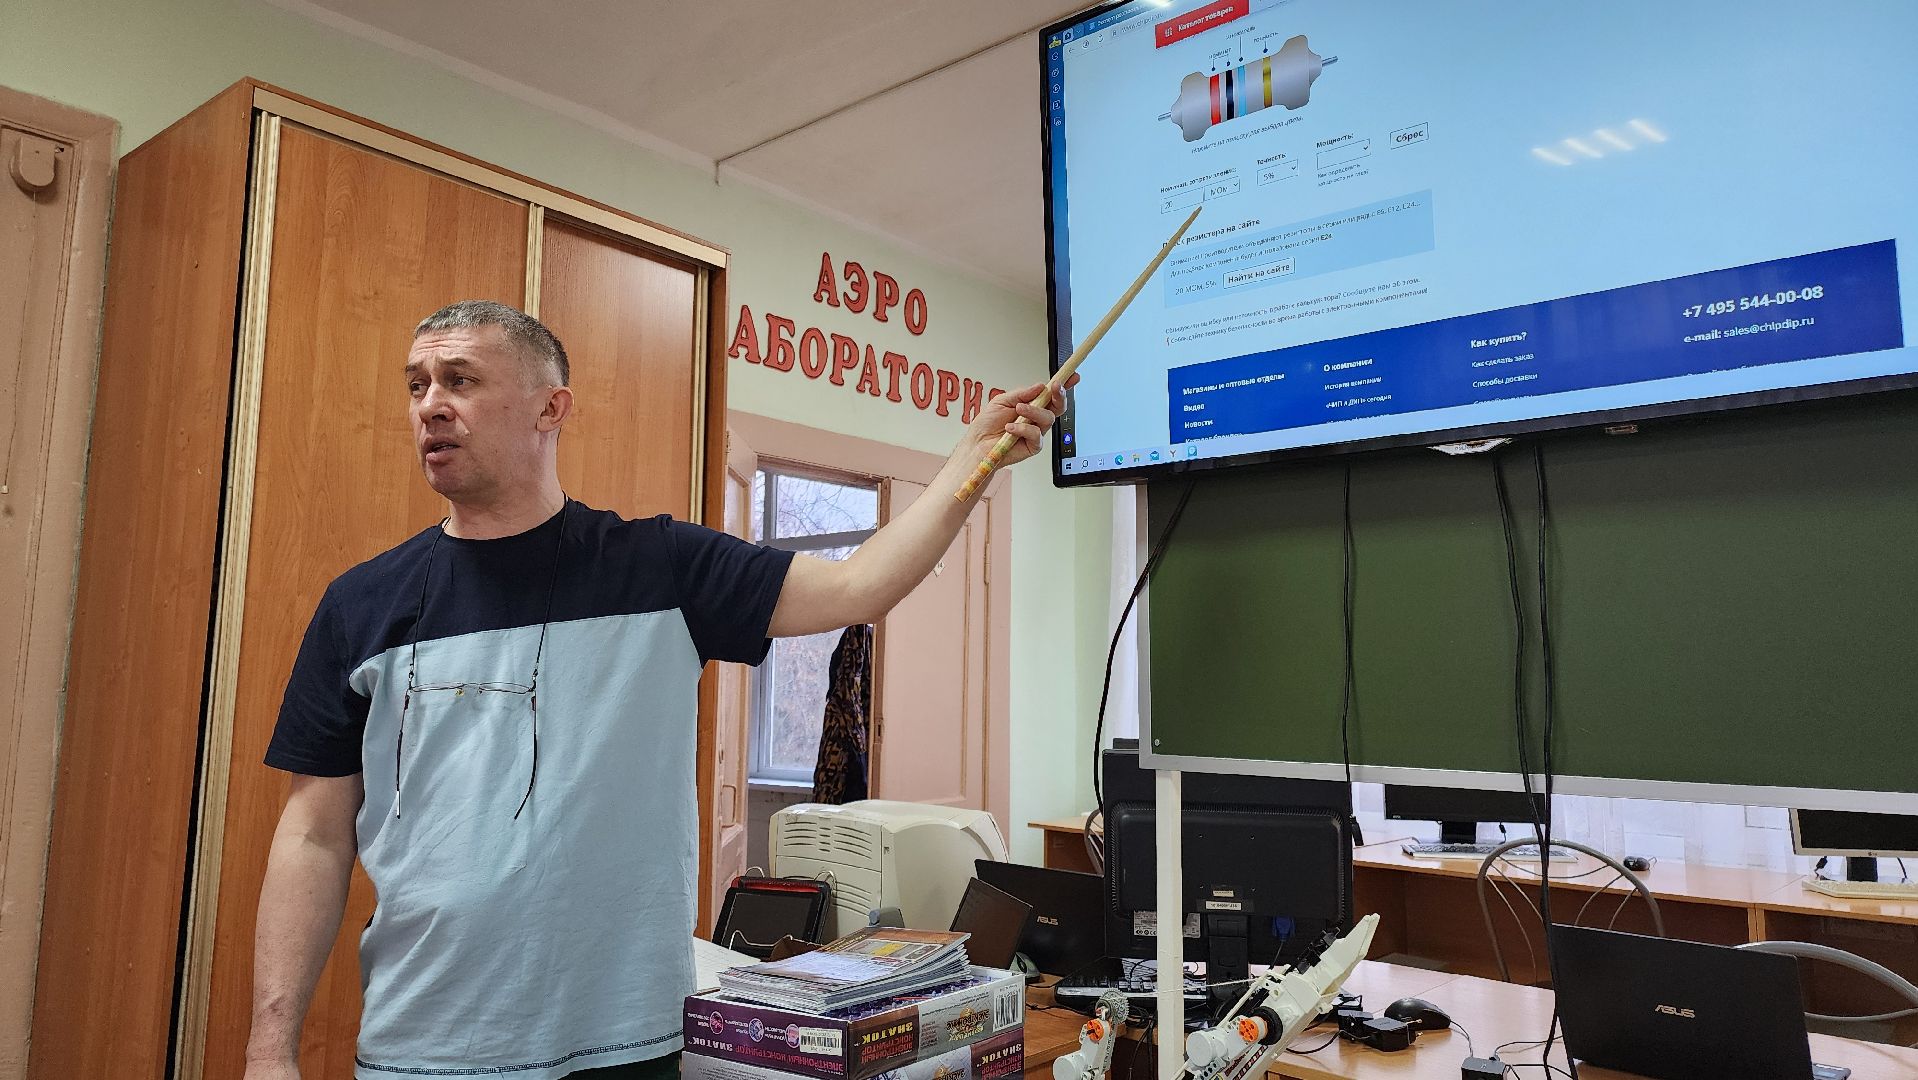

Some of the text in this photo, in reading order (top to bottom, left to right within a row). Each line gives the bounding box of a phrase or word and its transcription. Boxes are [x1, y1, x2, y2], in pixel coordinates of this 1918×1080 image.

[1395, 130, 1424, 143] Сброс
[1238, 219, 1261, 230] сайте
[1228, 270, 1254, 284] Найти
[1266, 264, 1290, 275] сайте
[813, 251, 928, 336] АЭРО
[1682, 284, 1824, 318] +7 495 544-00-08
[1683, 316, 1815, 343] e-mail: sales@chipdip.ru
[1470, 331, 1527, 349] Как купить?
[728, 304, 1006, 425] АБОРАТОРИ
[1331, 358, 1373, 371] компании
[1514, 353, 1535, 362] заказ
[1256, 373, 1286, 384] отделы
[1324, 381, 1350, 391] История
[1472, 373, 1538, 388] Способы доставки
[1366, 394, 1392, 403] сегодня
[1184, 419, 1214, 429] Новости
[1037, 916, 1059, 926] ASUS
[1654, 1004, 1696, 1019] ASUS
[861, 1021, 914, 1045] ЗНАТОК
[691, 1036, 733, 1052] ЗНАТОК
[981, 1043, 1022, 1064] ЗНАТОК
